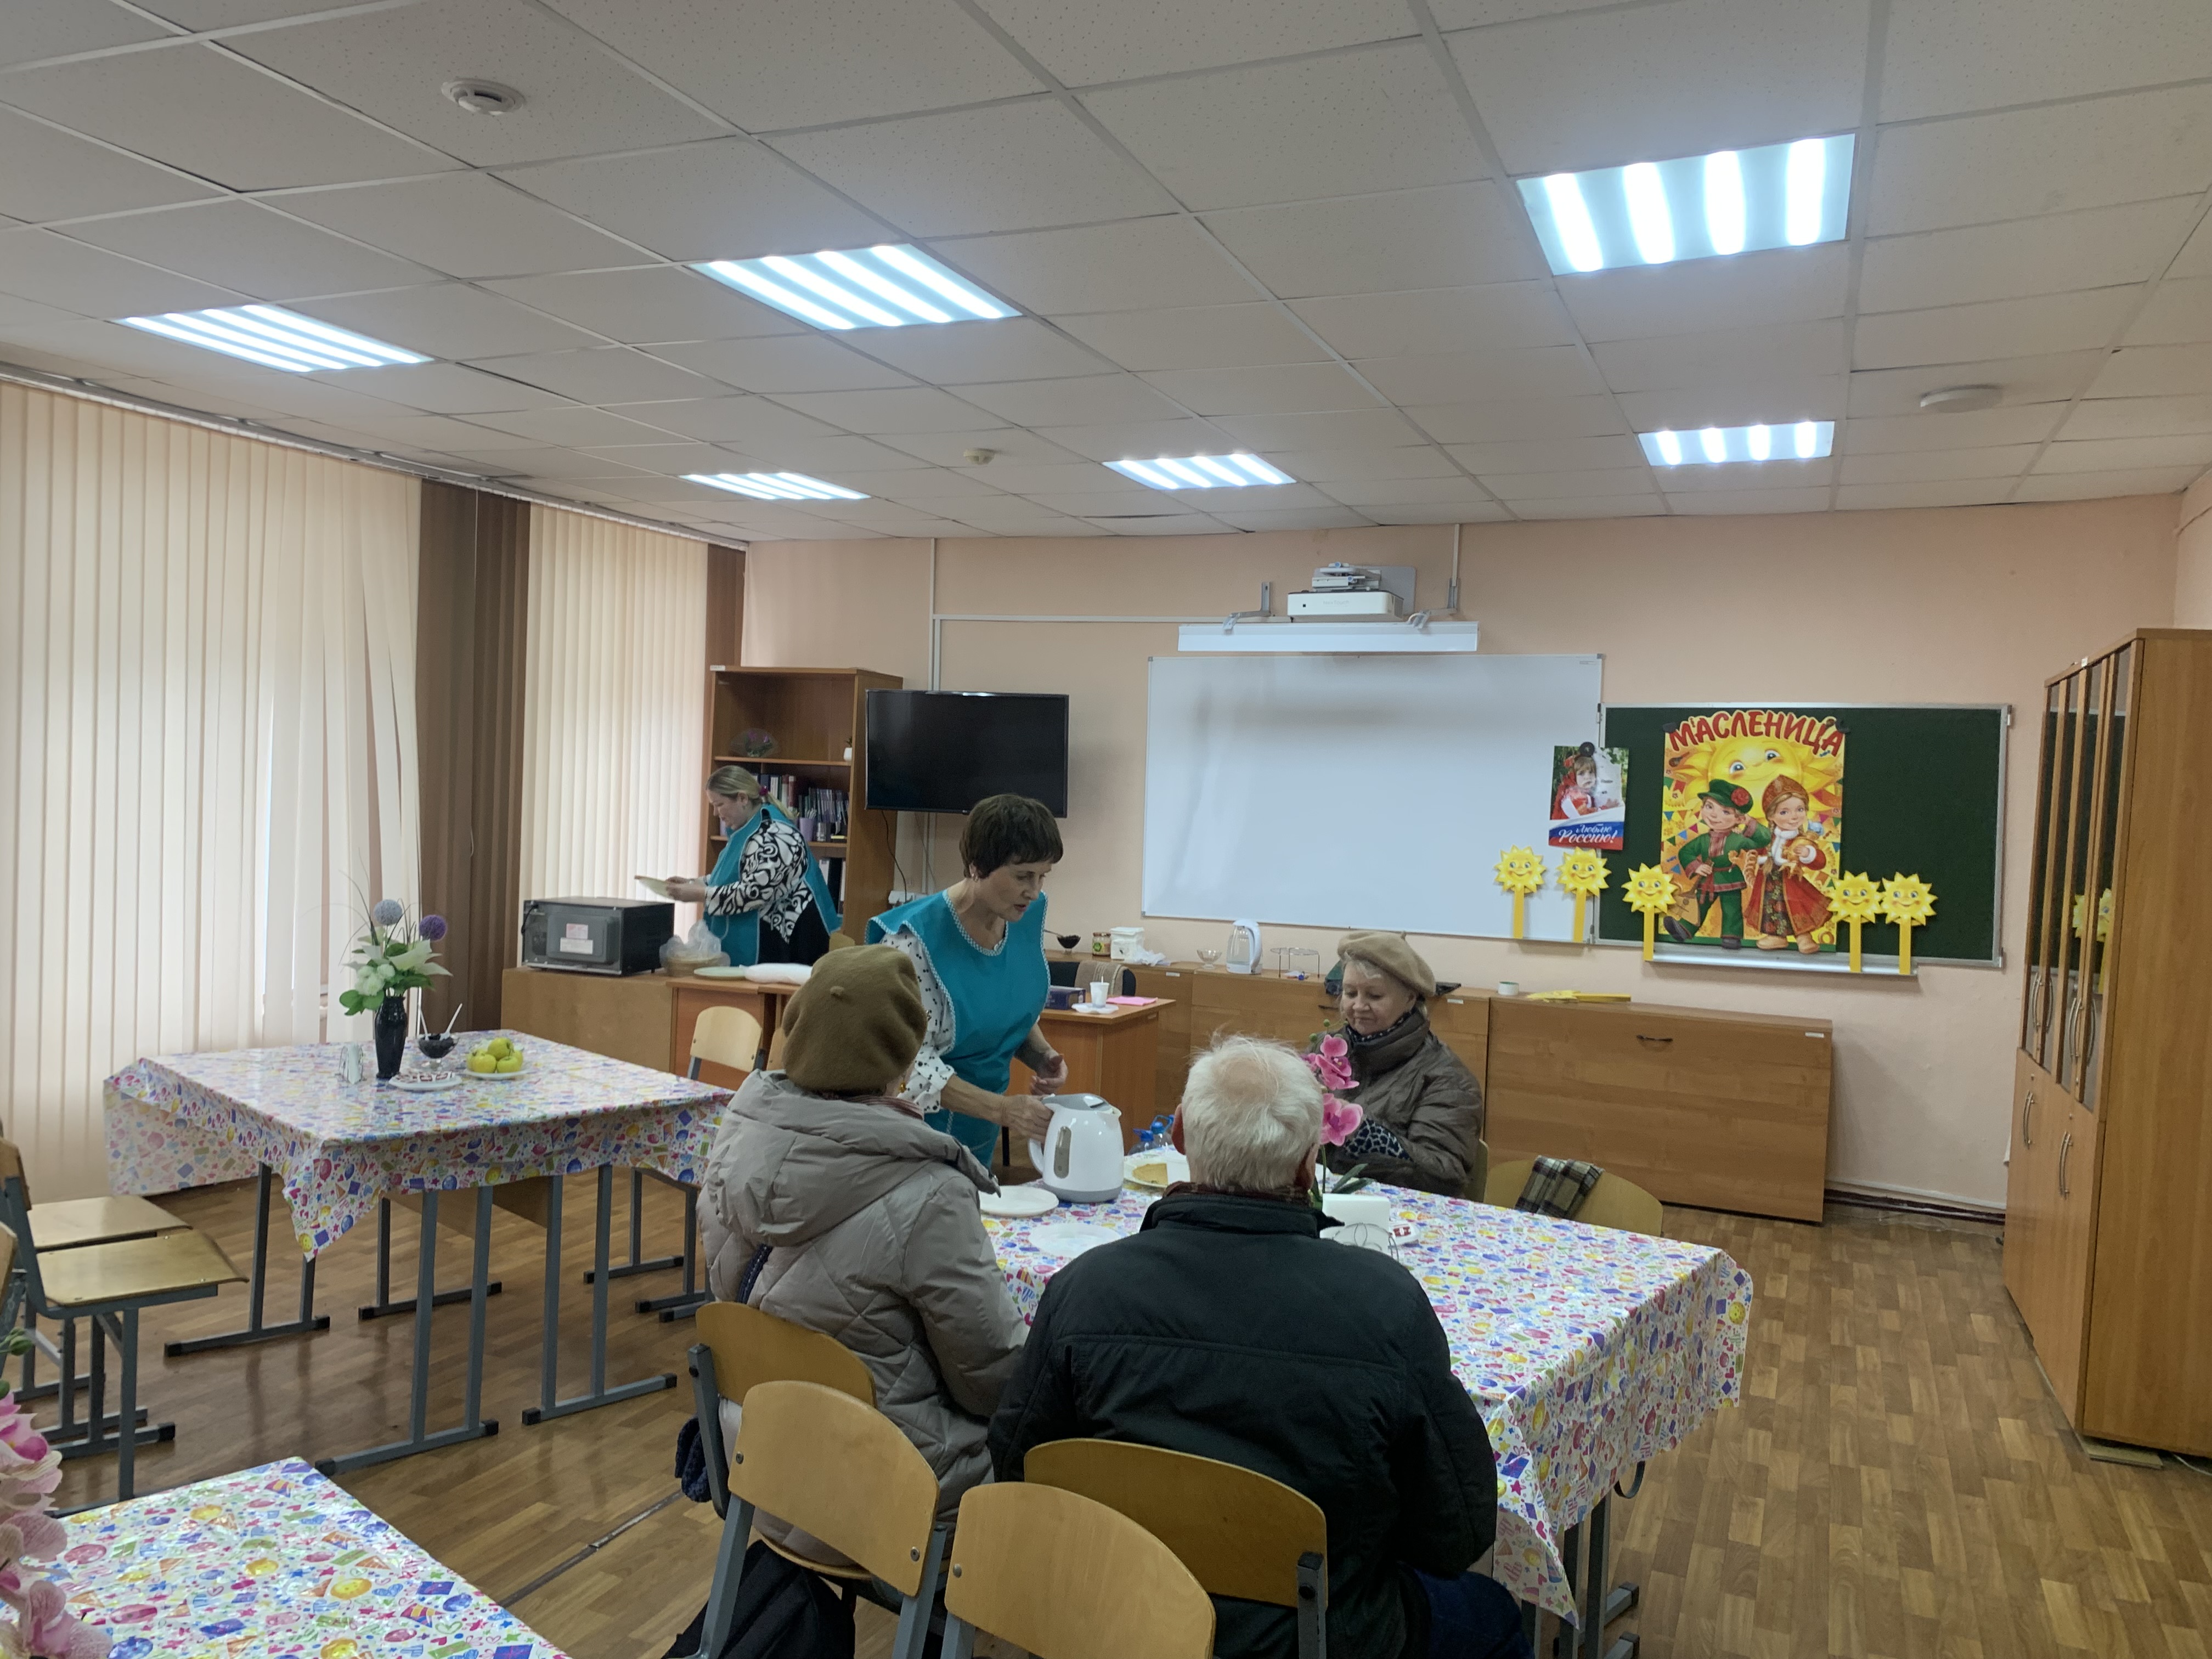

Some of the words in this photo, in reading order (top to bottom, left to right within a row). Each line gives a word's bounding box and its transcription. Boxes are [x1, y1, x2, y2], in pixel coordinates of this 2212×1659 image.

[1669, 710, 1844, 757] МАСЛЕНИЦА
[1576, 823, 1612, 834] Люблю
[1558, 829, 1618, 843] Россию!
